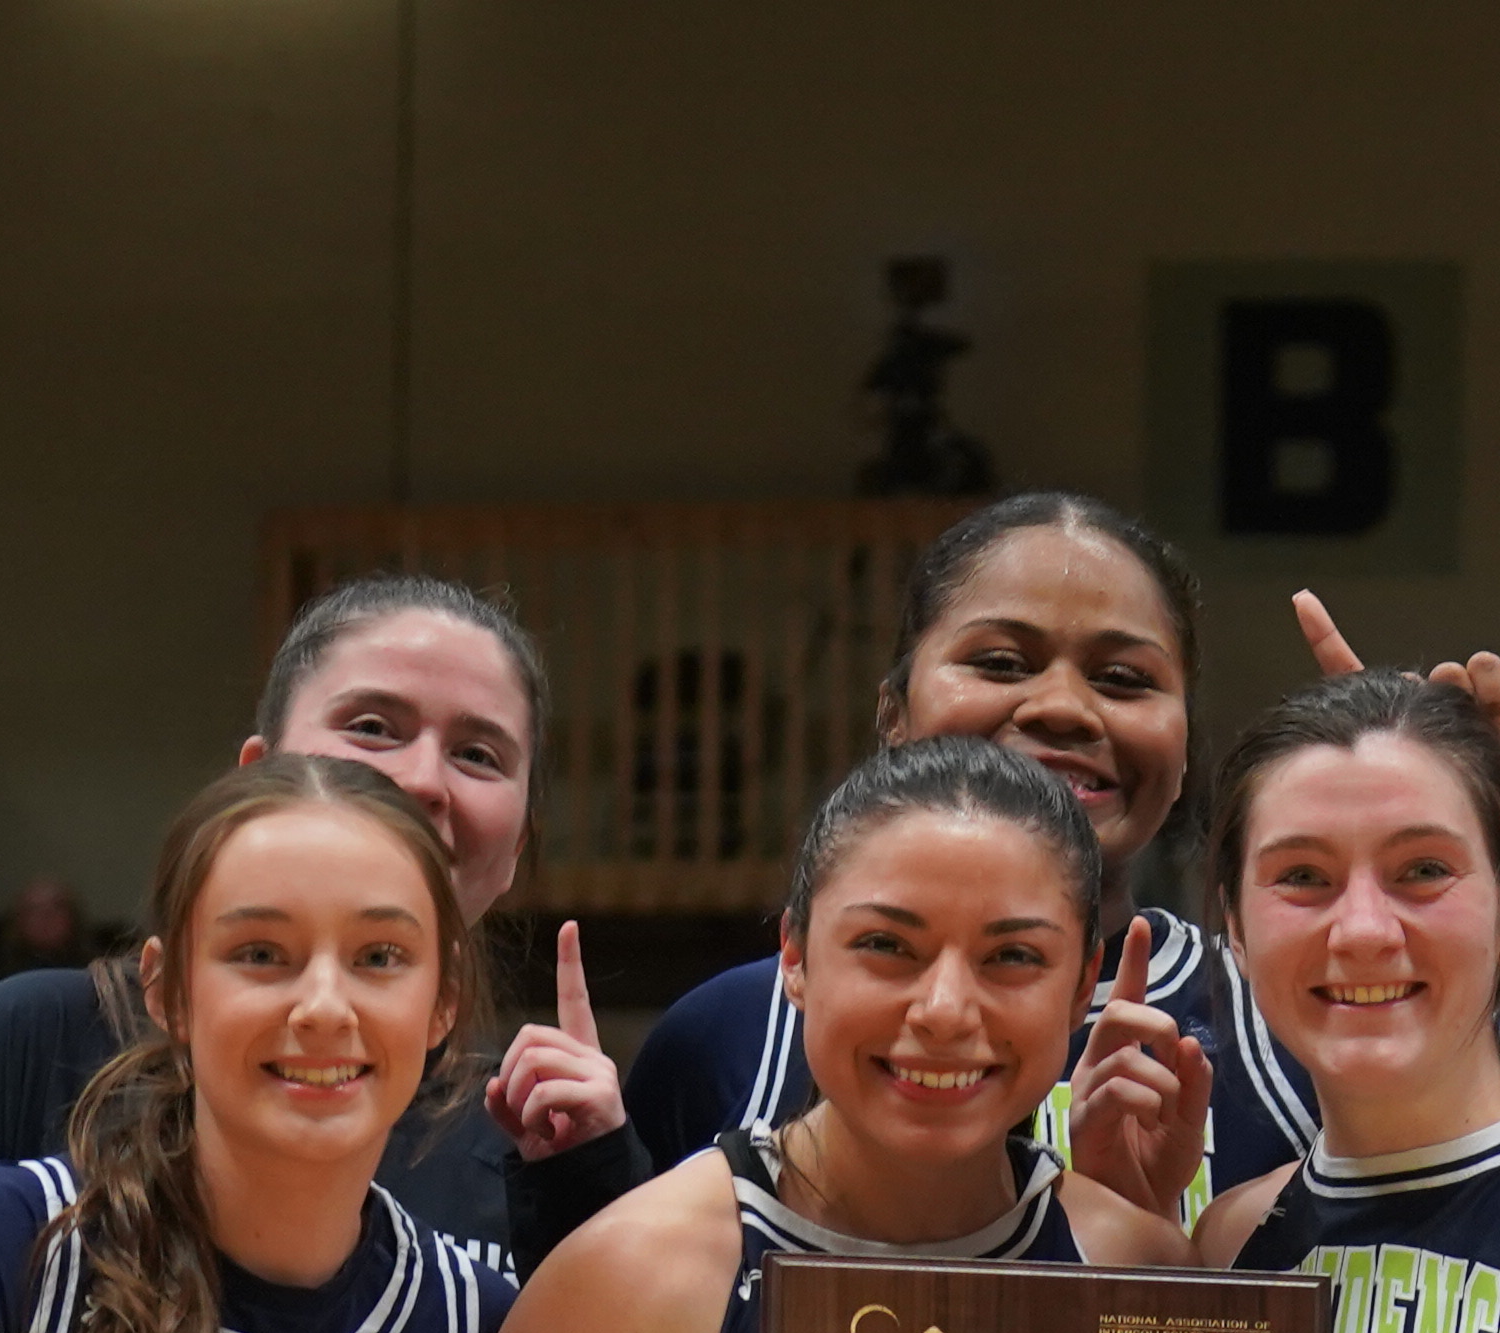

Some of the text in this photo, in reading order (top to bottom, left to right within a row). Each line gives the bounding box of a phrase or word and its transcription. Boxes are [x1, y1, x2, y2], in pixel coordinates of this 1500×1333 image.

[1220, 296, 1396, 537] B
[1100, 1315, 1271, 1329] NATIONAL ASSOCIATION OF
